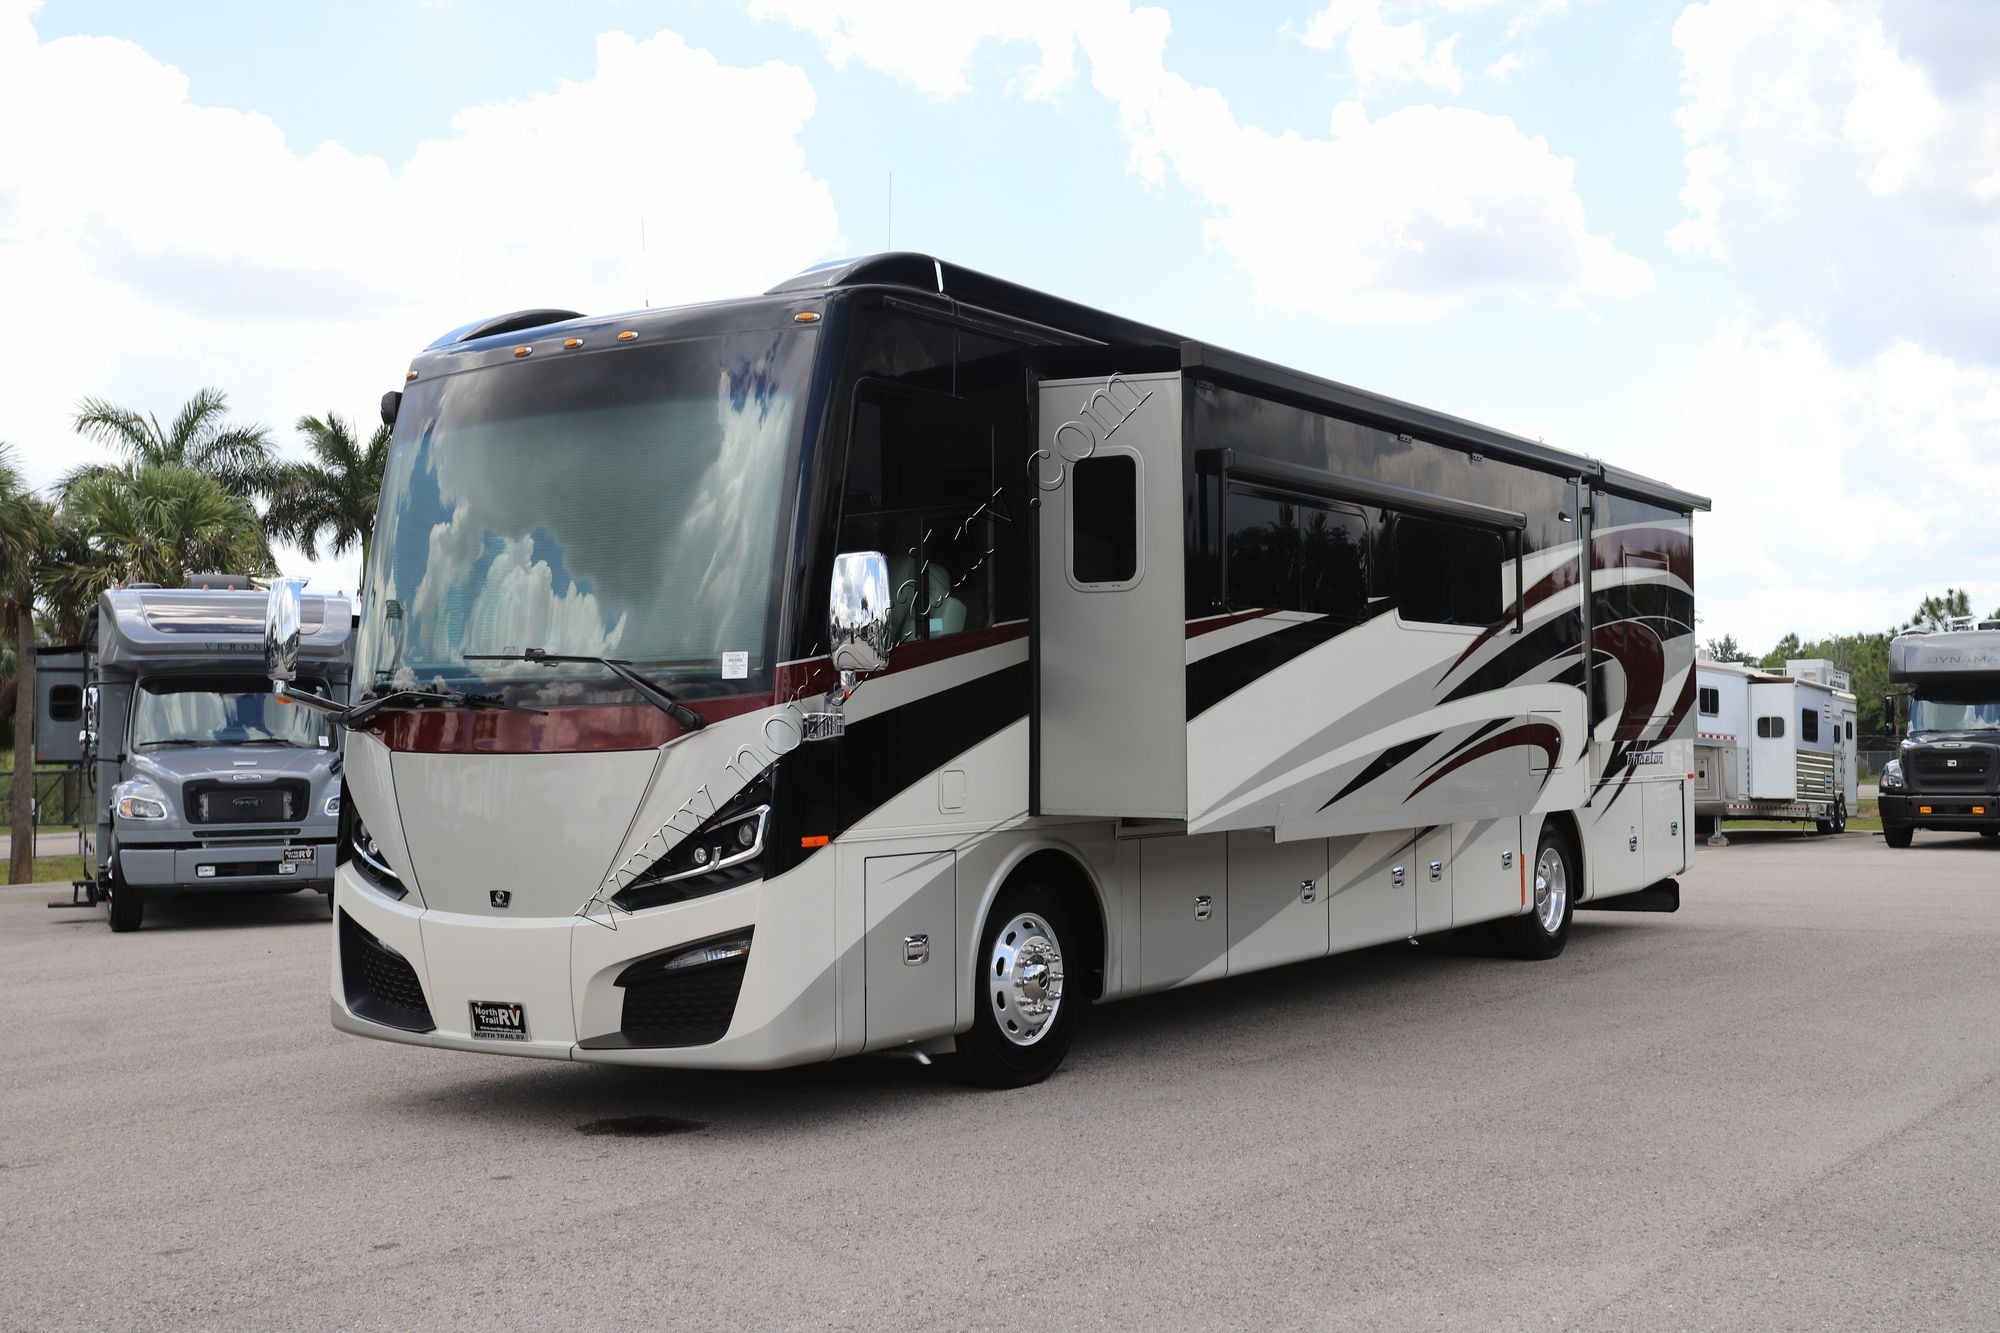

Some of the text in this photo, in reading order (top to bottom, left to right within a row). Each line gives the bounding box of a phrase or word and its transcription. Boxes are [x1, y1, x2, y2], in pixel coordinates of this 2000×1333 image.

[205, 643, 262, 651] VERON
[1926, 656, 2000, 664] DYNAMA
[299, 850, 312, 859] RV
[475, 1007, 497, 1016] North
[480, 1015, 499, 1024] Trail
[498, 1008, 520, 1026] RV
